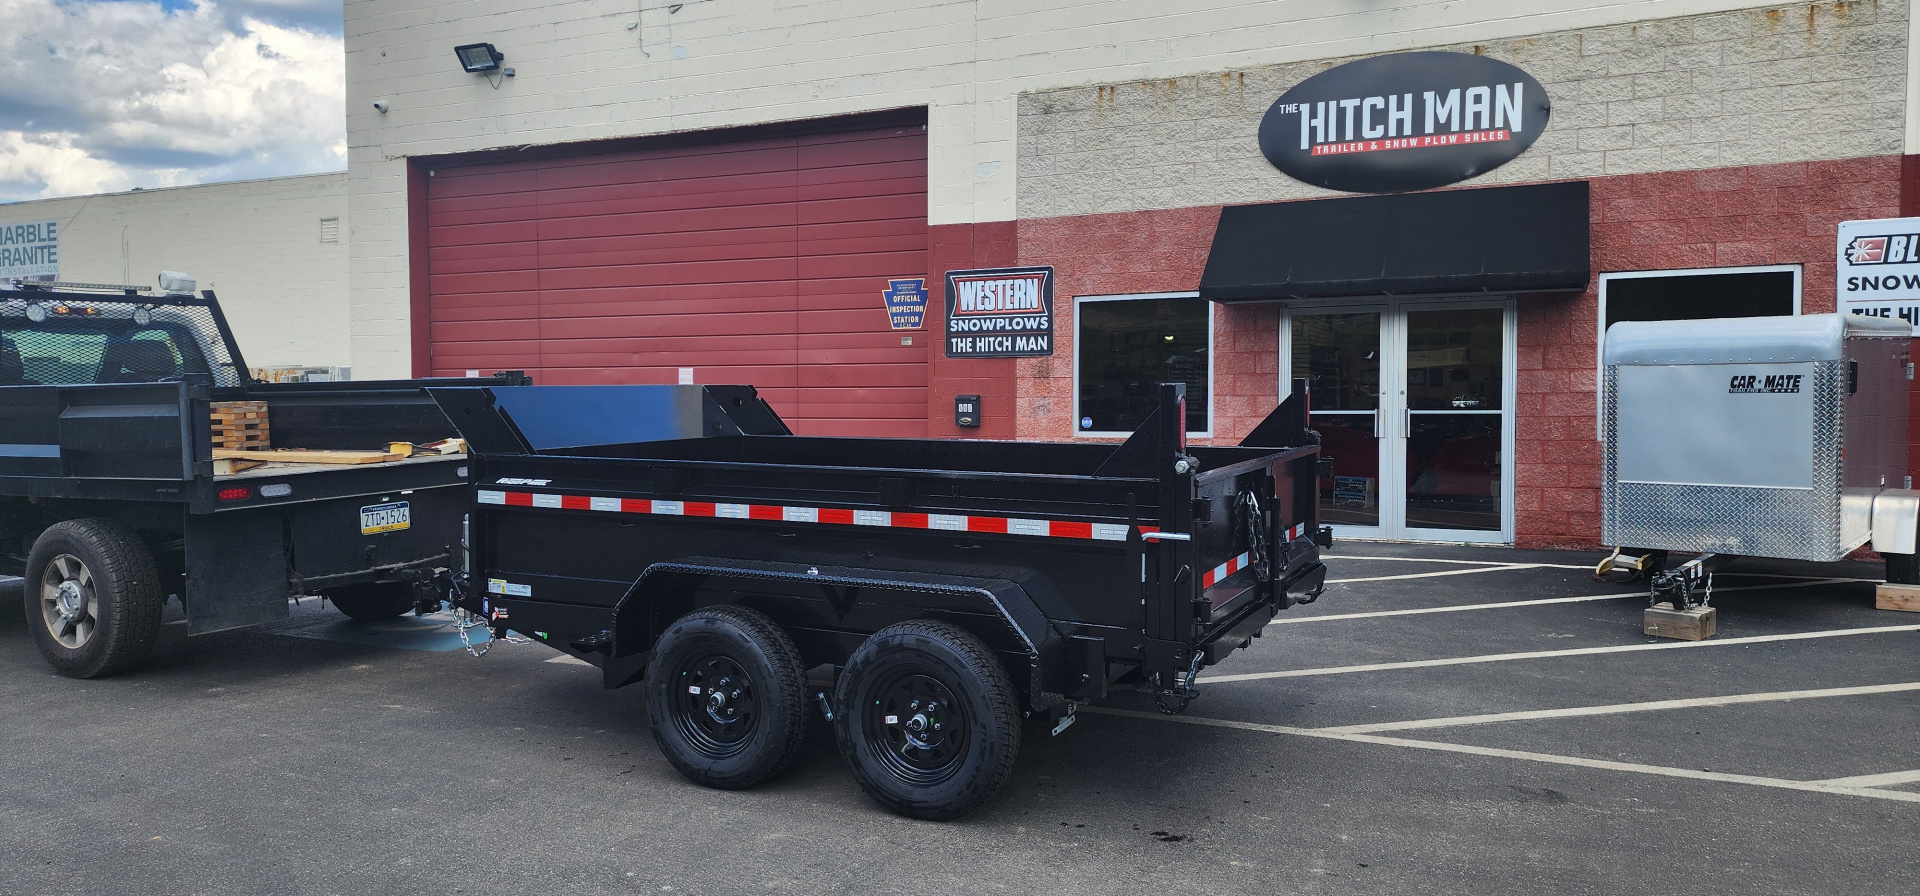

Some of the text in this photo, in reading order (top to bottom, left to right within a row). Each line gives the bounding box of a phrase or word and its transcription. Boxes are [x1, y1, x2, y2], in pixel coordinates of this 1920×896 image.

[1279, 82, 1524, 150] THE HITCH MAN
[1316, 131, 1502, 155] TRAILER & SNOW PLOW SALES
[0, 222, 57, 246] ARBLE
[0, 244, 58, 268] RANITE
[4, 265, 59, 277] INSTALLATION
[893, 294, 921, 303] OFFICIAL
[958, 278, 1039, 312] WESTERN
[889, 305, 924, 313] INSPECTION
[893, 315, 919, 324] STATION
[950, 316, 1049, 332] SNOWPLOWS
[951, 335, 1048, 353] THE HITCH MAN
[1730, 374, 1802, 389] CAR MATE
